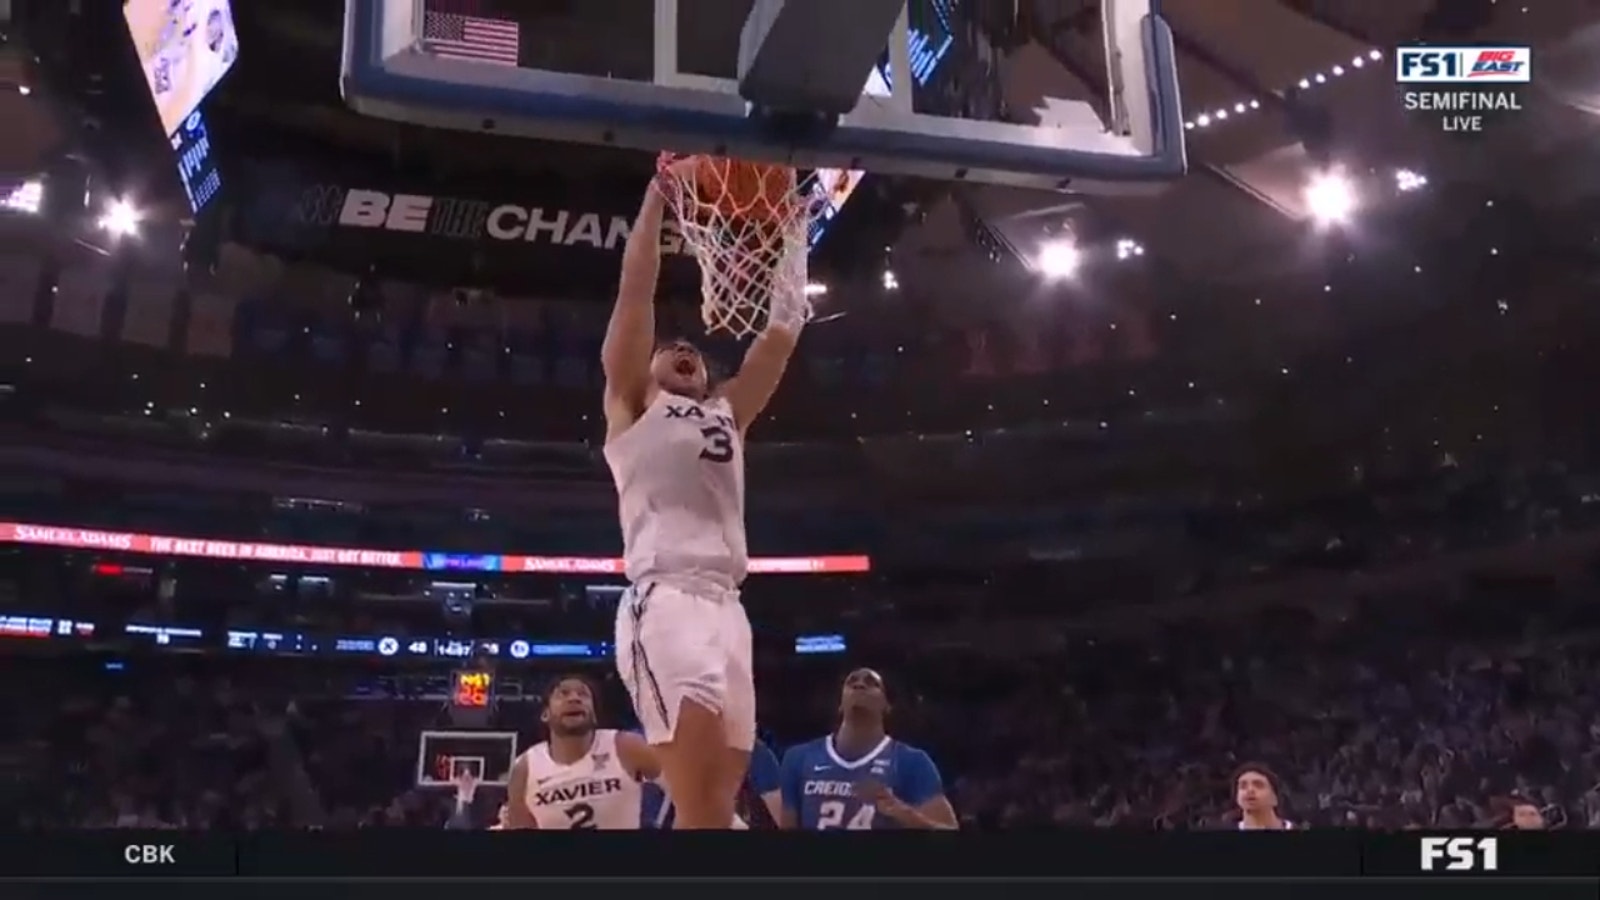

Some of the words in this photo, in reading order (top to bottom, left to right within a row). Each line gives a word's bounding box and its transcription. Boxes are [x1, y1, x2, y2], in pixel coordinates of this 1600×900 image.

[699, 427, 734, 463] 3
[535, 777, 622, 806] XAVIER
[563, 802, 598, 829] 2
[816, 800, 877, 830] 24
